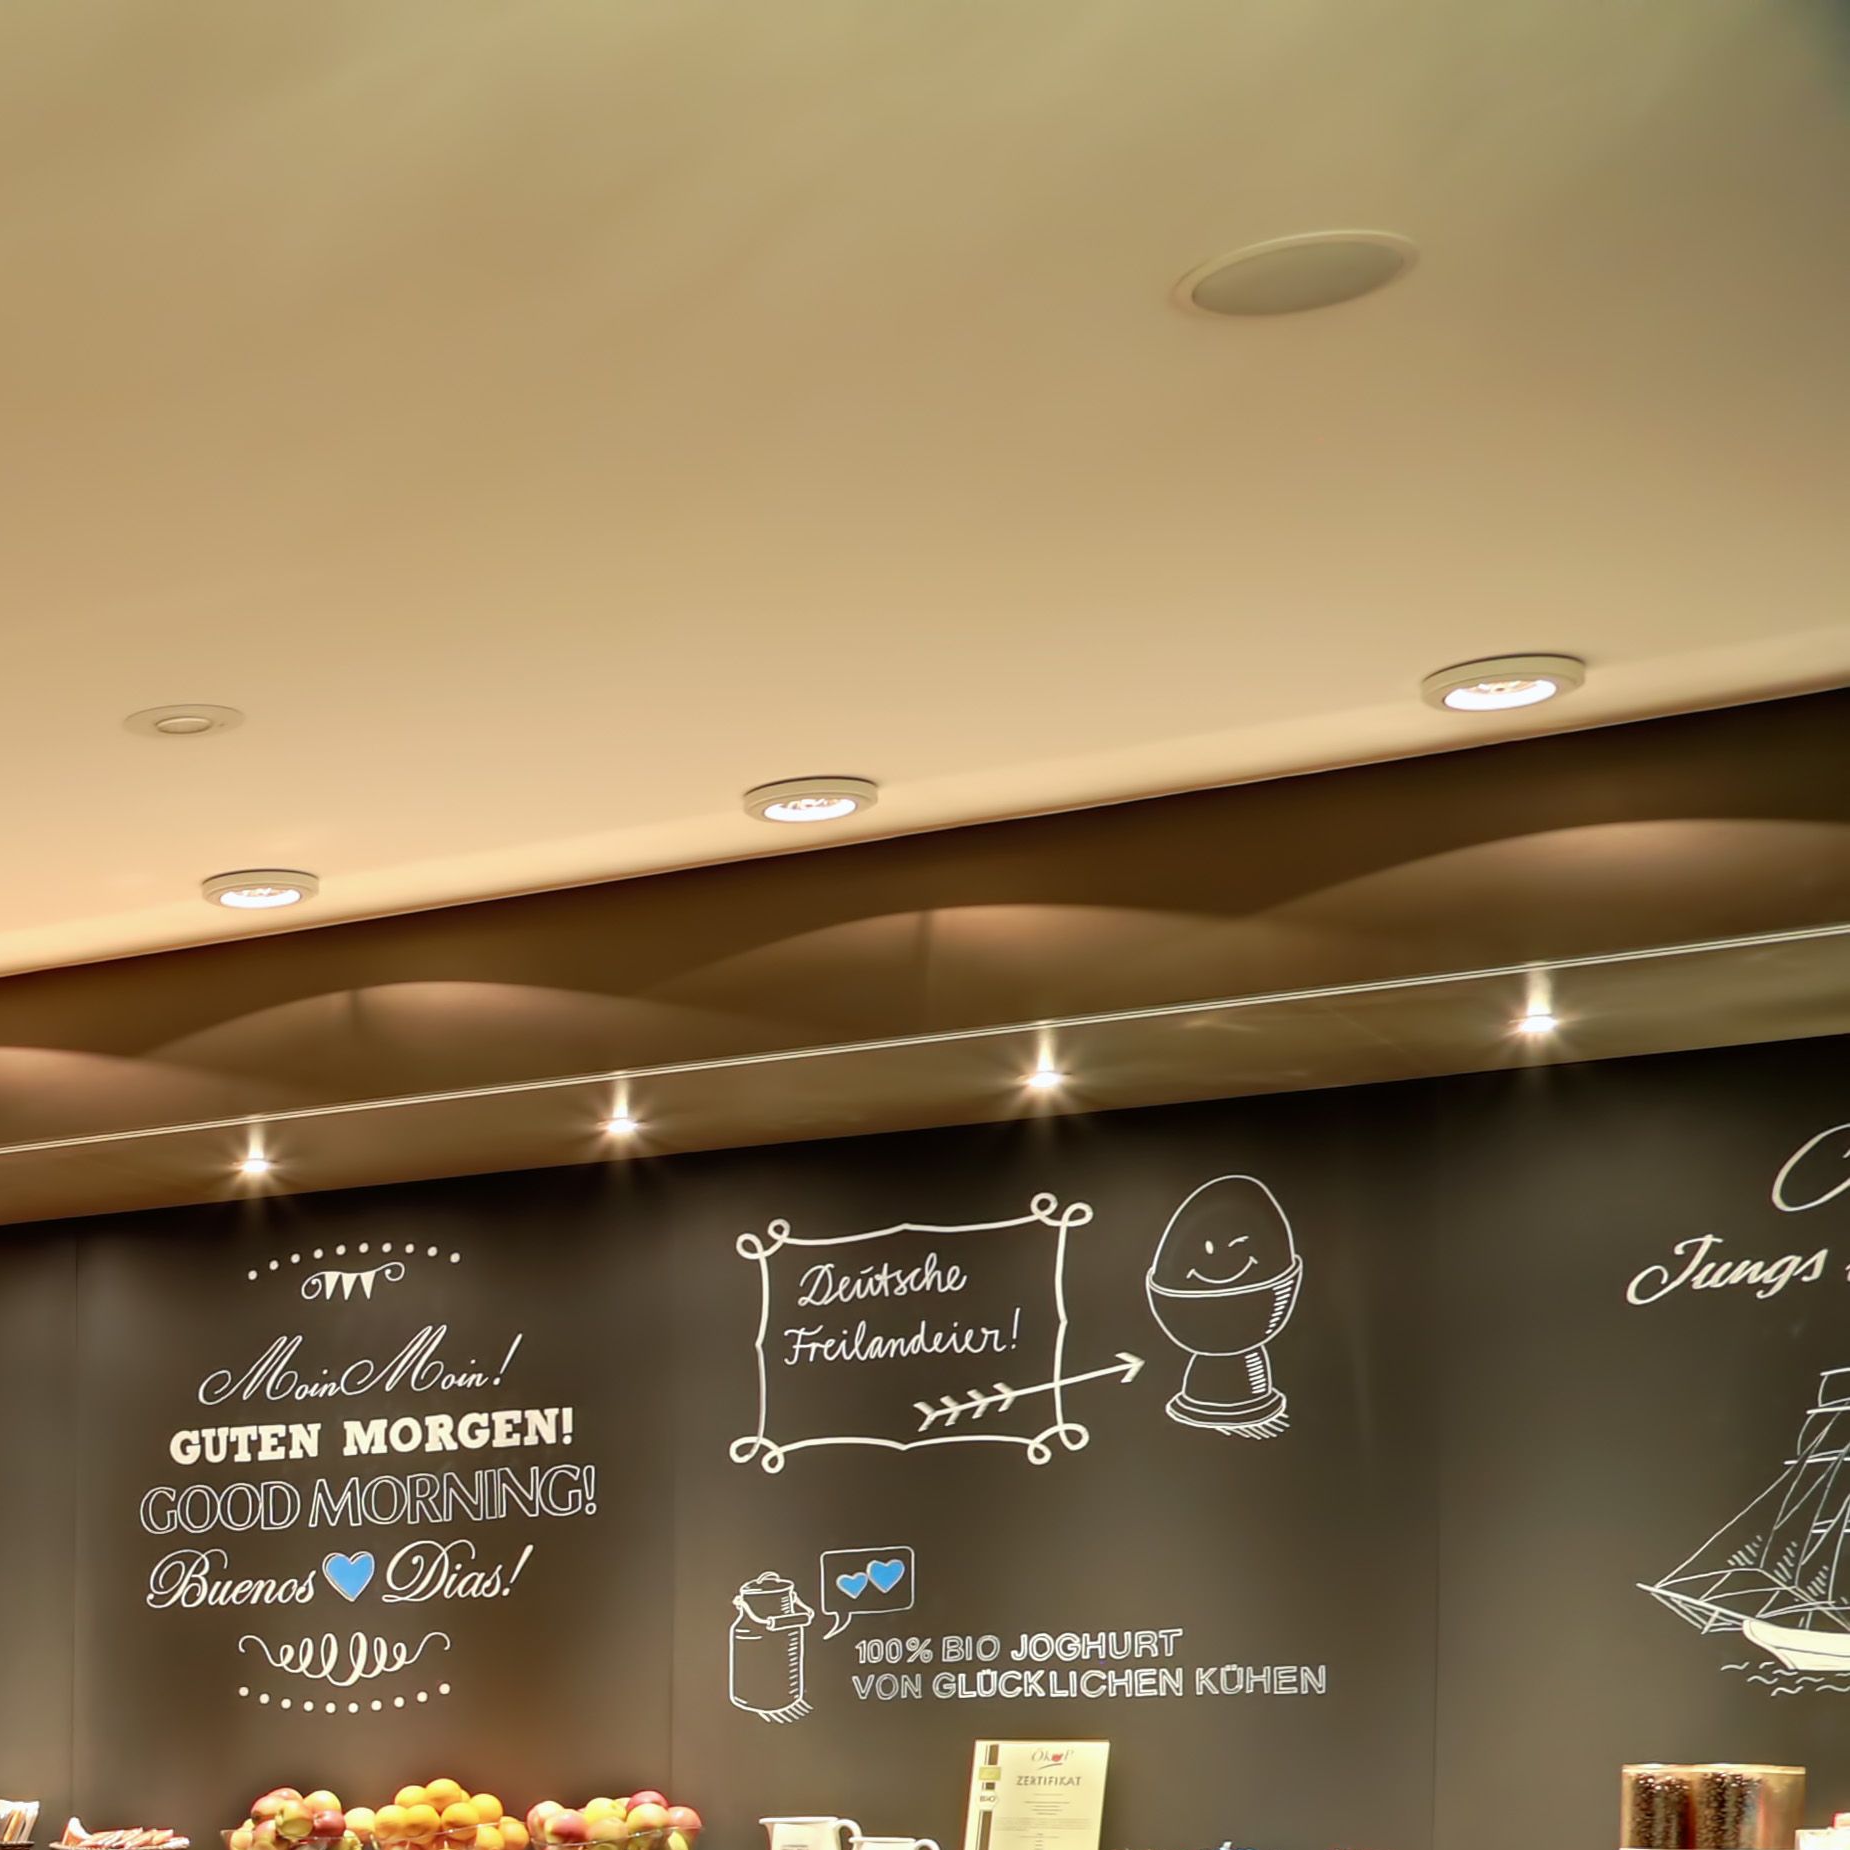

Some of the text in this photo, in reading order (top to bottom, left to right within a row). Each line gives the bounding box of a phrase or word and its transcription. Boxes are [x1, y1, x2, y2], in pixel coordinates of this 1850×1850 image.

[1626, 1233, 1829, 1306] Jungs
[783, 1307, 1021, 1366] Freilandeier!
[198, 1334, 341, 1406] Moin
[169, 1406, 574, 1466] GUTEN MORGEN!
[139, 1464, 598, 1535] GOOD MORNING!
[145, 1539, 535, 1610] Buenos Dias!
[854, 1628, 1184, 1665] 100% BIO JOGHURT
[851, 1664, 1328, 1701] VON GLÜCKLICHEN KÜHEN
[1016, 1776, 1081, 1786] ZERTIFIKAT
